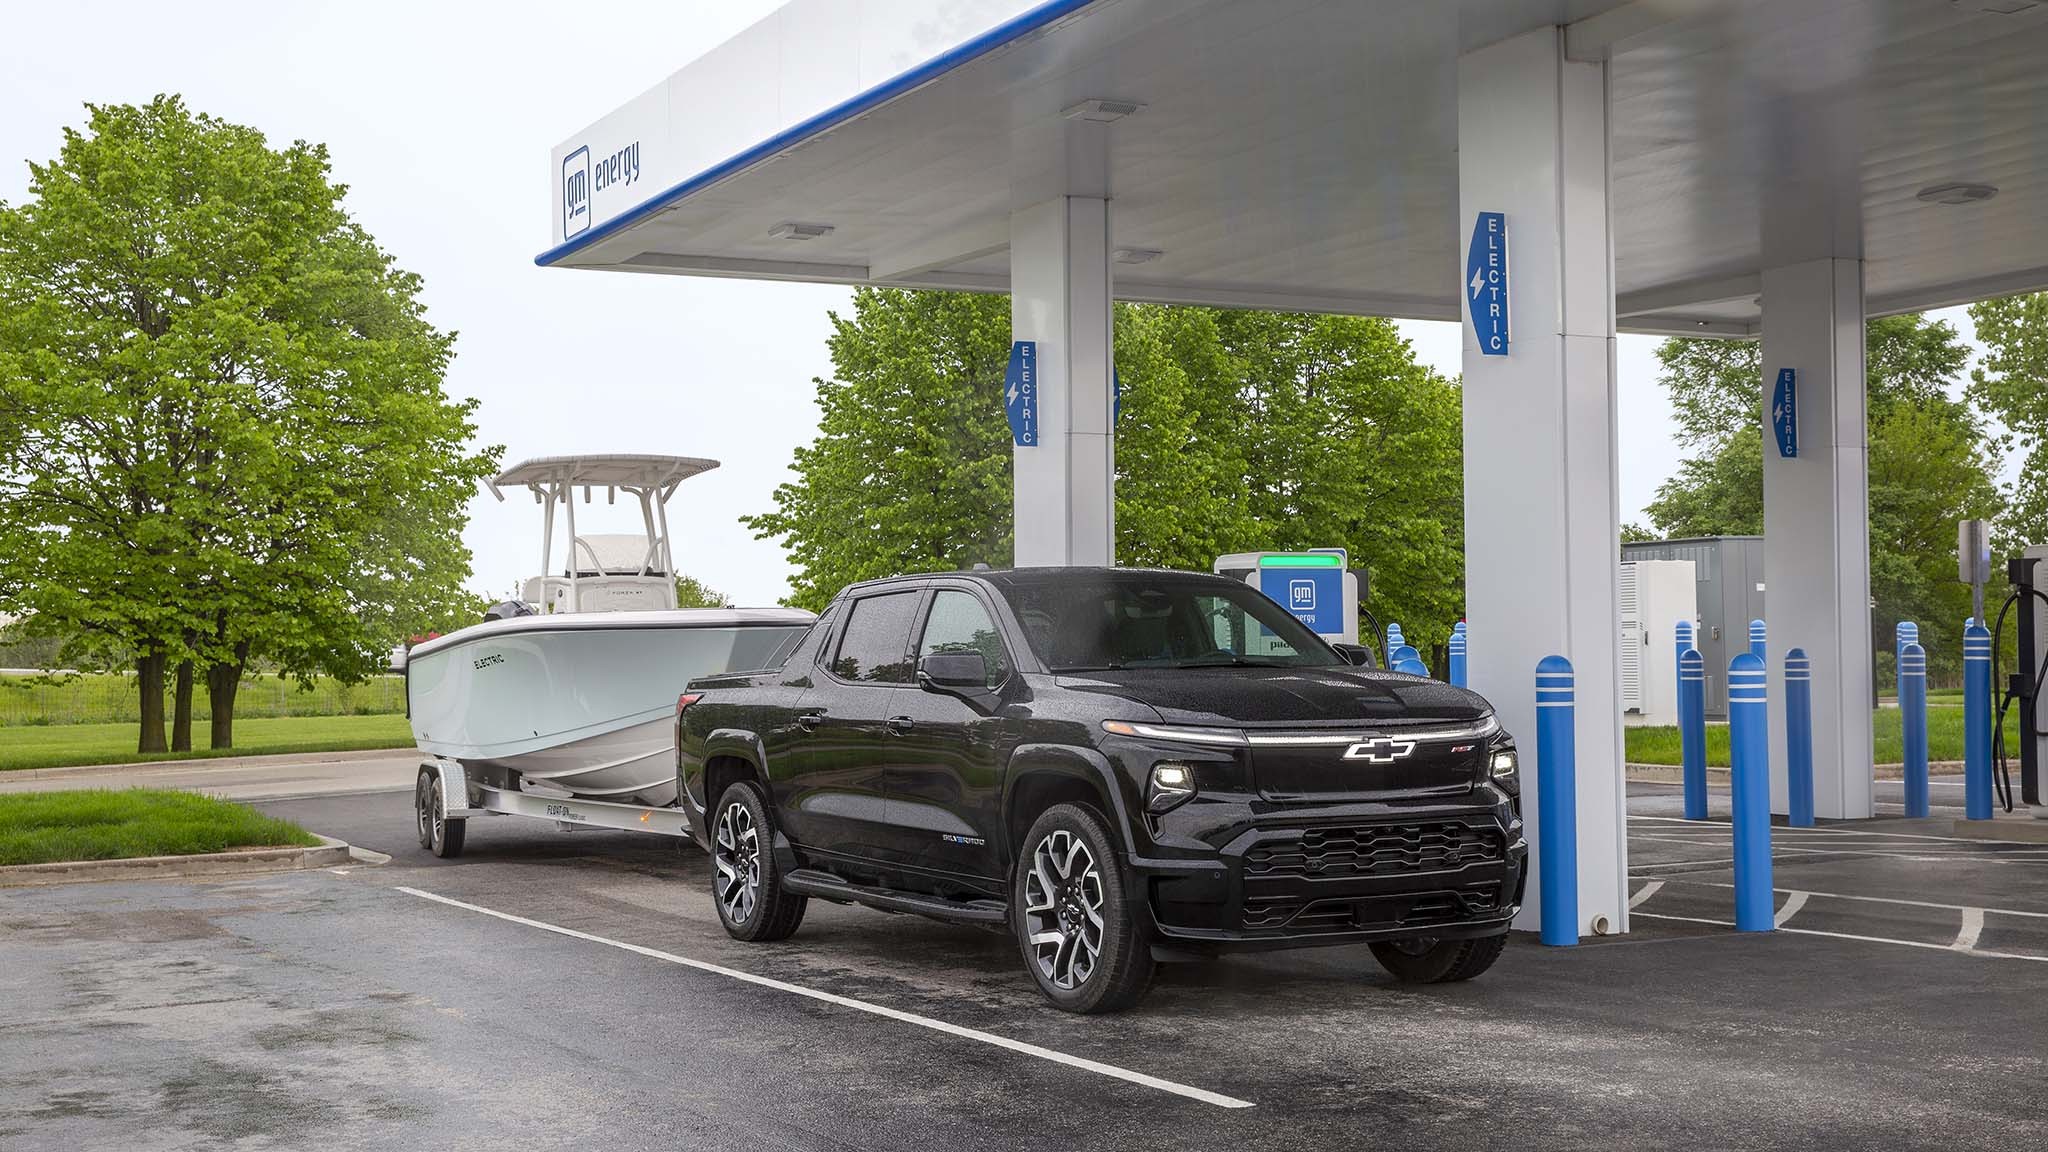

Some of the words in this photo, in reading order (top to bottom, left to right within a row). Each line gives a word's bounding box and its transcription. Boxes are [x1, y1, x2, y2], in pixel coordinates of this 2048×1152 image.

[567, 169, 586, 219] gm
[595, 141, 640, 192] energy
[1488, 218, 1502, 350] ELECTRIC
[1021, 346, 1032, 443] ELECTRIC
[1784, 372, 1793, 454] ELECTRIC
[1294, 587, 1312, 602] gm
[1295, 614, 1316, 623] nergy
[473, 654, 504, 670] ELECTRIC
